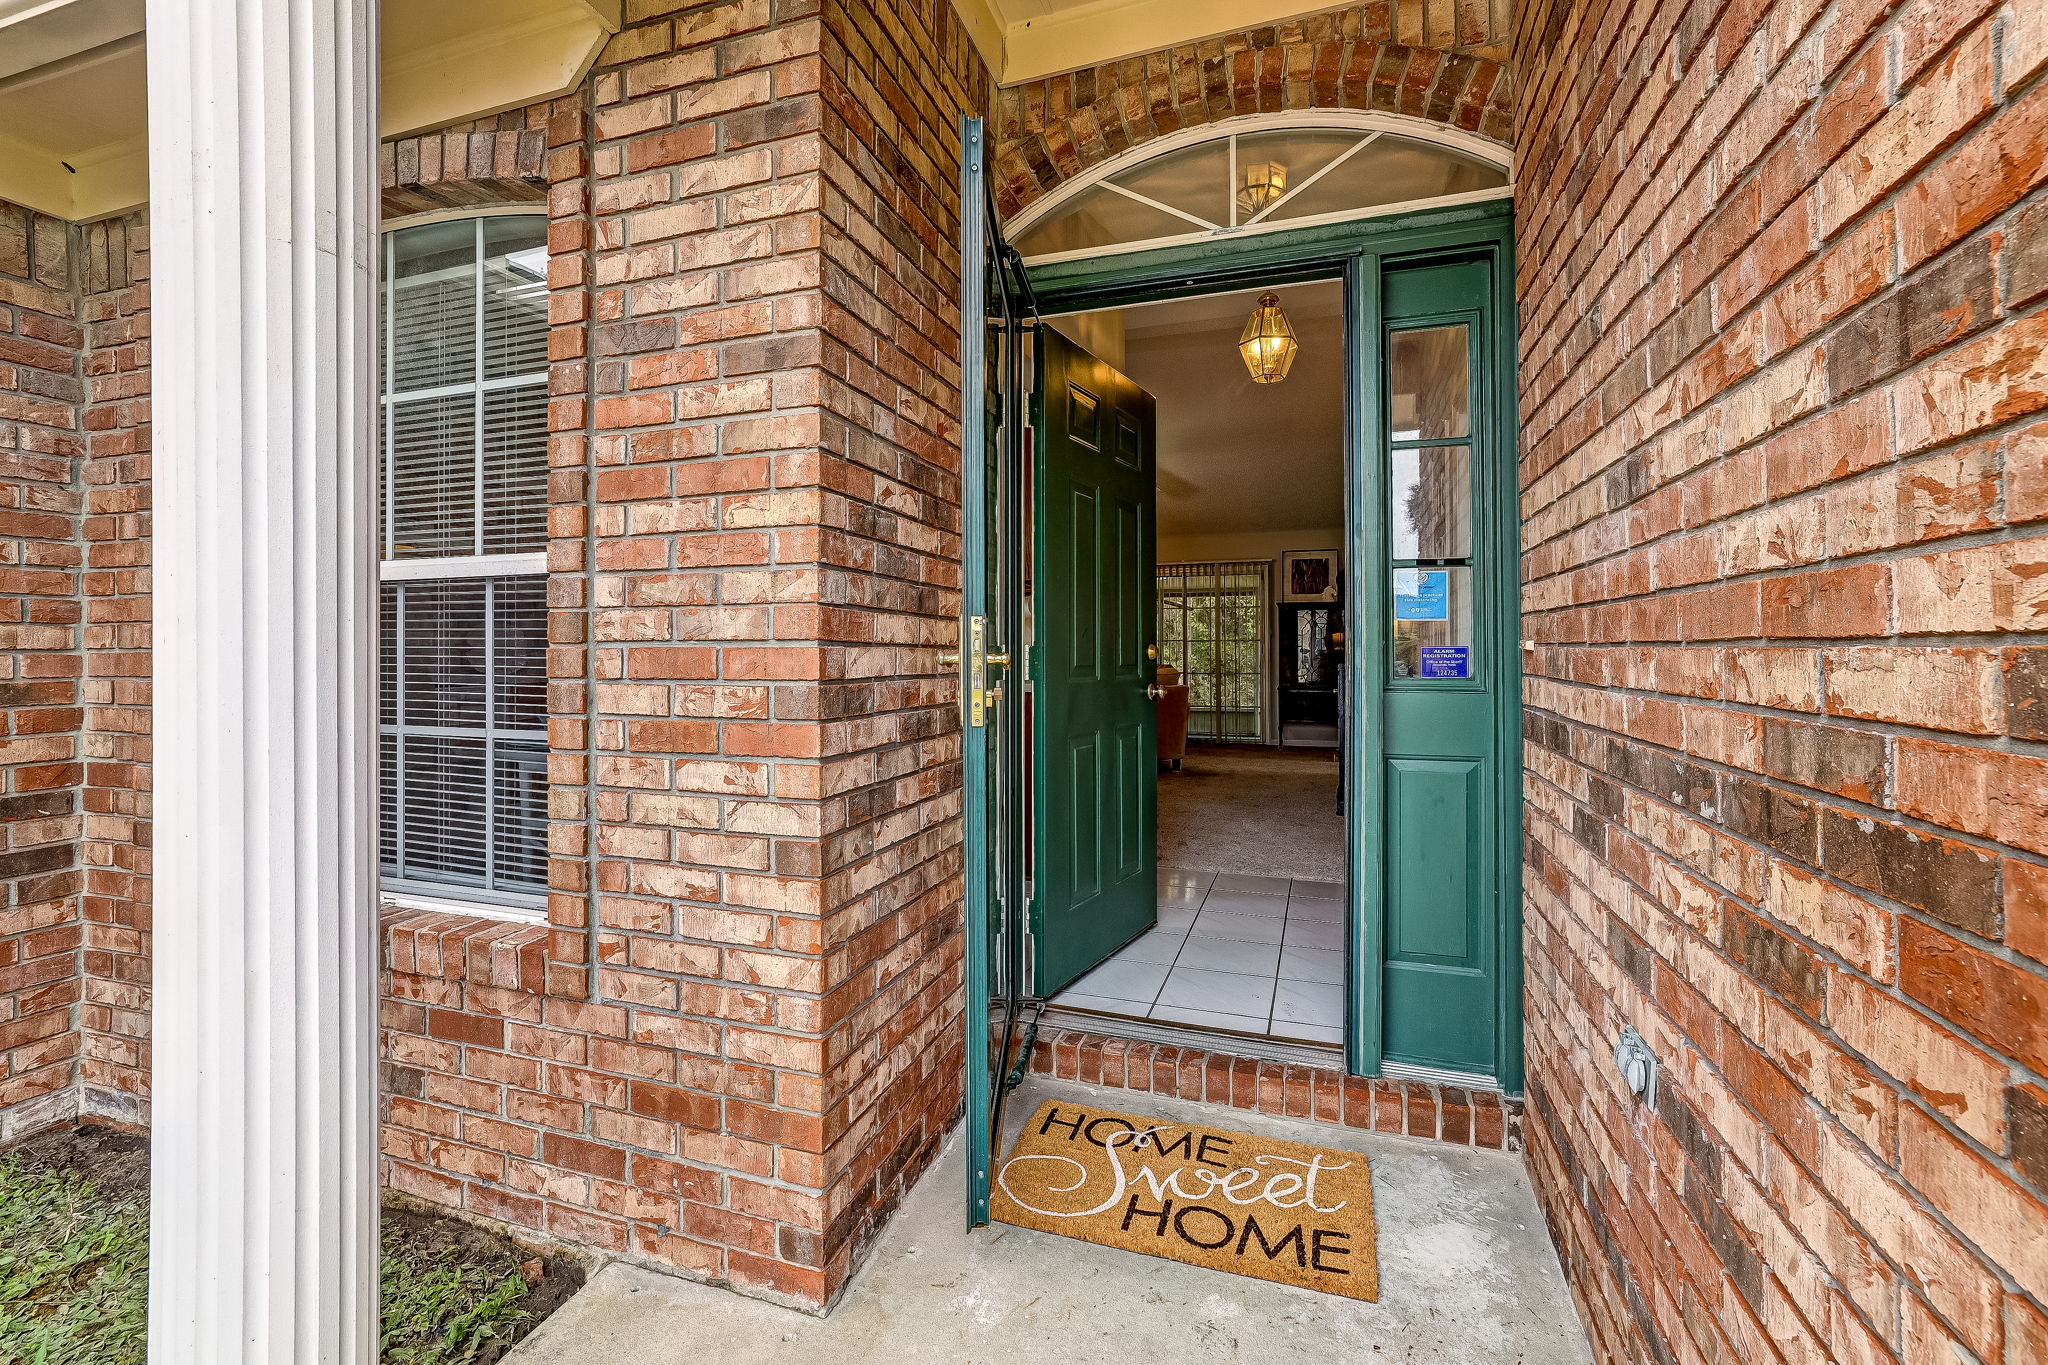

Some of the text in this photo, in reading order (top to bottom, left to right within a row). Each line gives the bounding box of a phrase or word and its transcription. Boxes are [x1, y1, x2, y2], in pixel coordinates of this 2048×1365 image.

[997, 1125, 1352, 1217] Sweet
[1038, 1108, 1233, 1168] HOME
[1121, 1193, 1351, 1275] HOME
